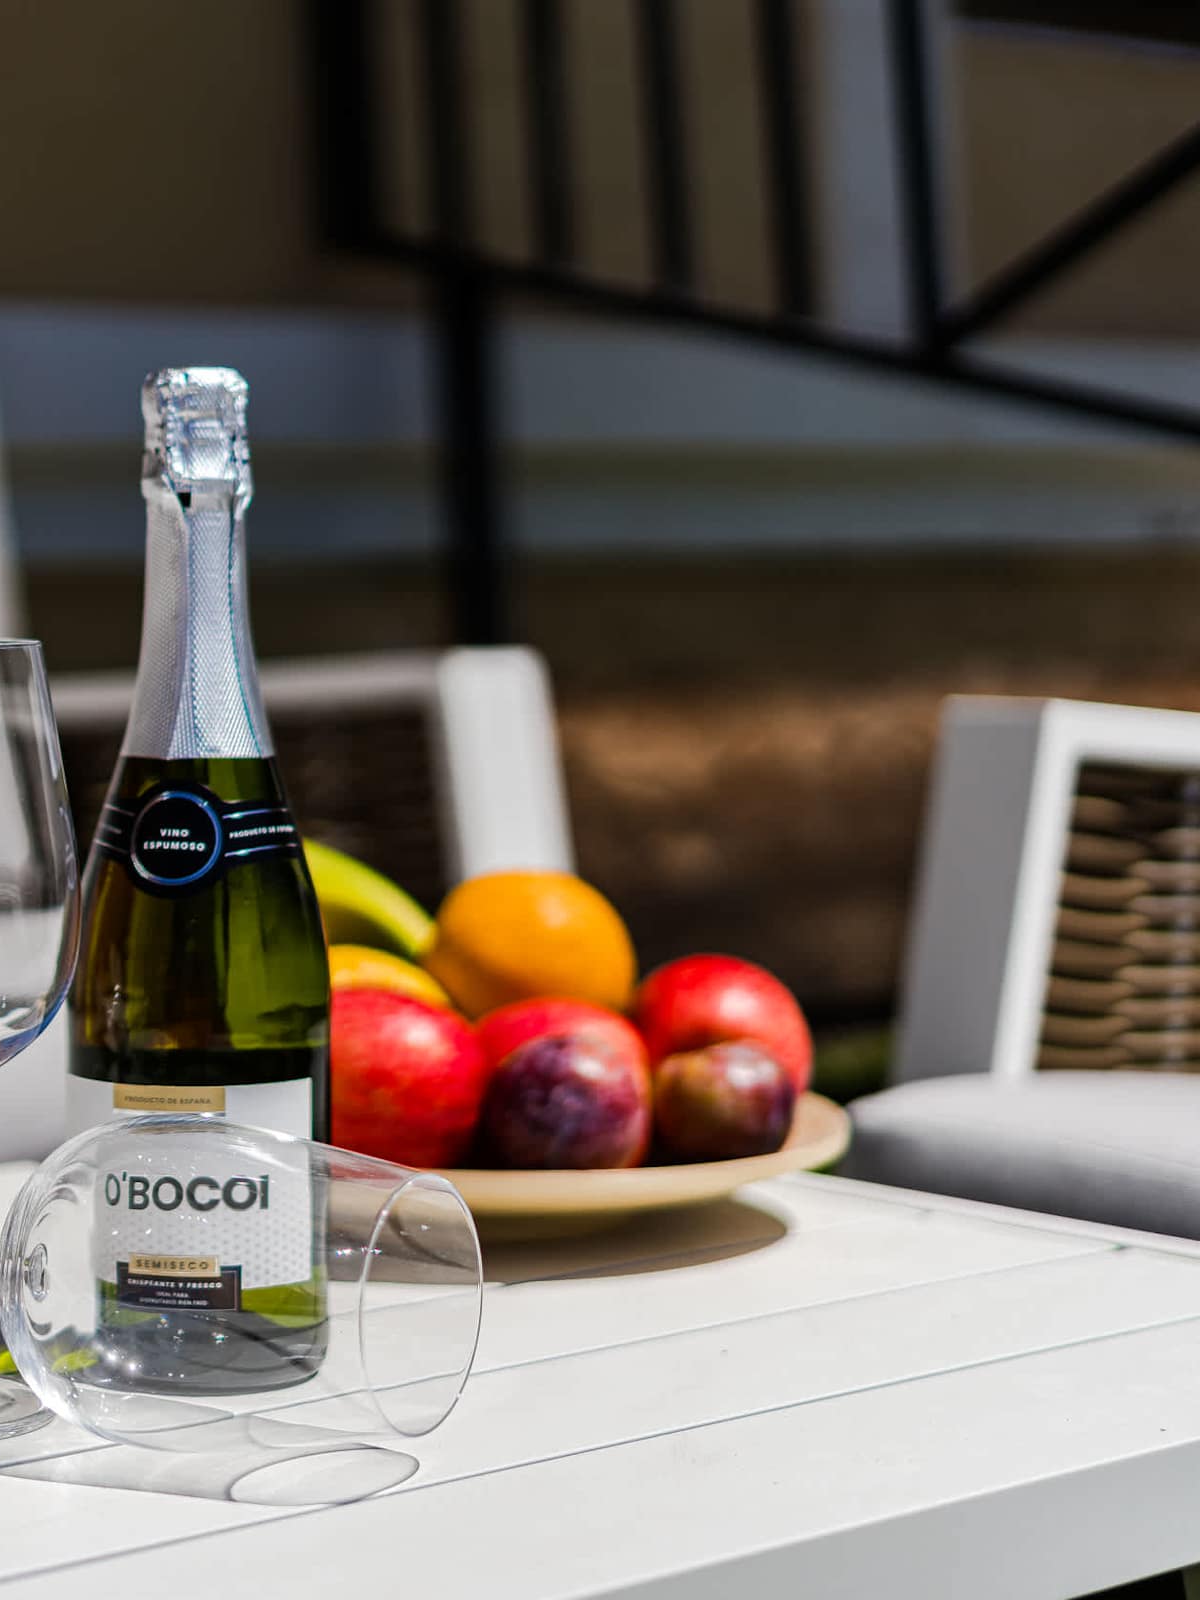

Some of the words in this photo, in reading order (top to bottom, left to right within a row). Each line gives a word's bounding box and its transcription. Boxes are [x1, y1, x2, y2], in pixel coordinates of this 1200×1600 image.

[160, 828, 189, 838] VINO
[143, 841, 206, 852] ESPUMOSO
[124, 1095, 165, 1104] PRODUCTO
[135, 1258, 210, 1270] SEMISECO
[178, 1281, 184, 1289] Y
[187, 1281, 223, 1289] FRESCO
